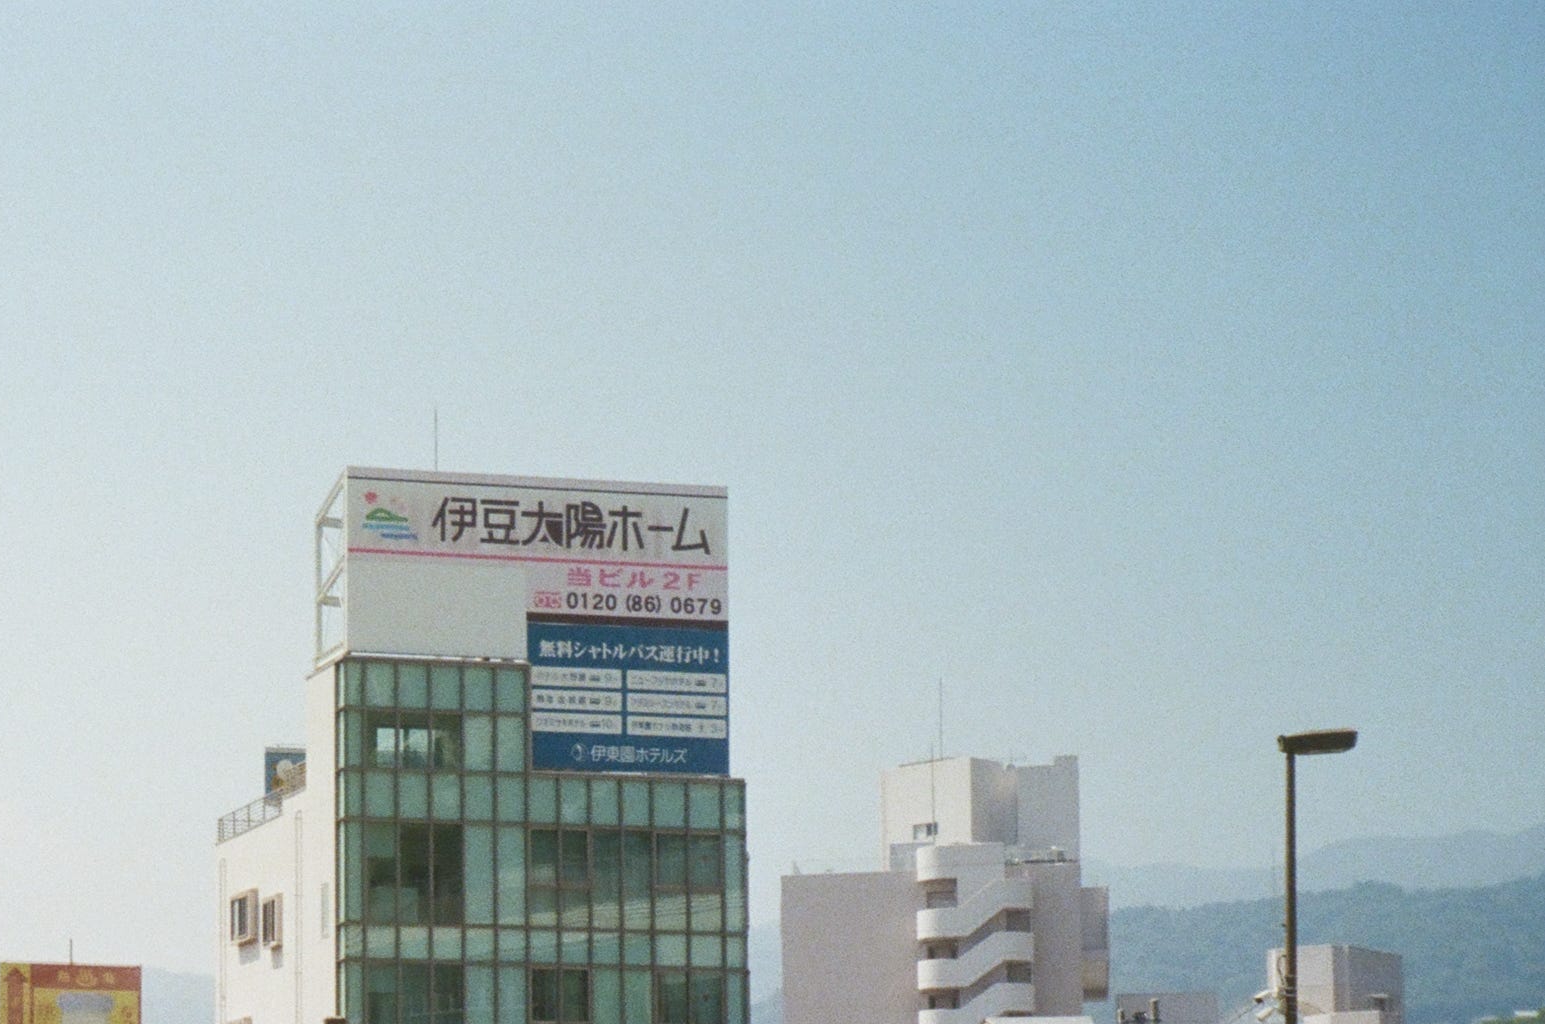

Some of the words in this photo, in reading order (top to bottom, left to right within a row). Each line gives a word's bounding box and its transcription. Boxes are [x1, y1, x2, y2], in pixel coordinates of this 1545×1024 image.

[432, 496, 712, 556] 伊豆太陽ホーム
[566, 592, 617, 611] 0120
[626, 594, 661, 613] (86)
[670, 596, 722, 616] 0679
[589, 744, 689, 764] 伊東園ホテルズ
